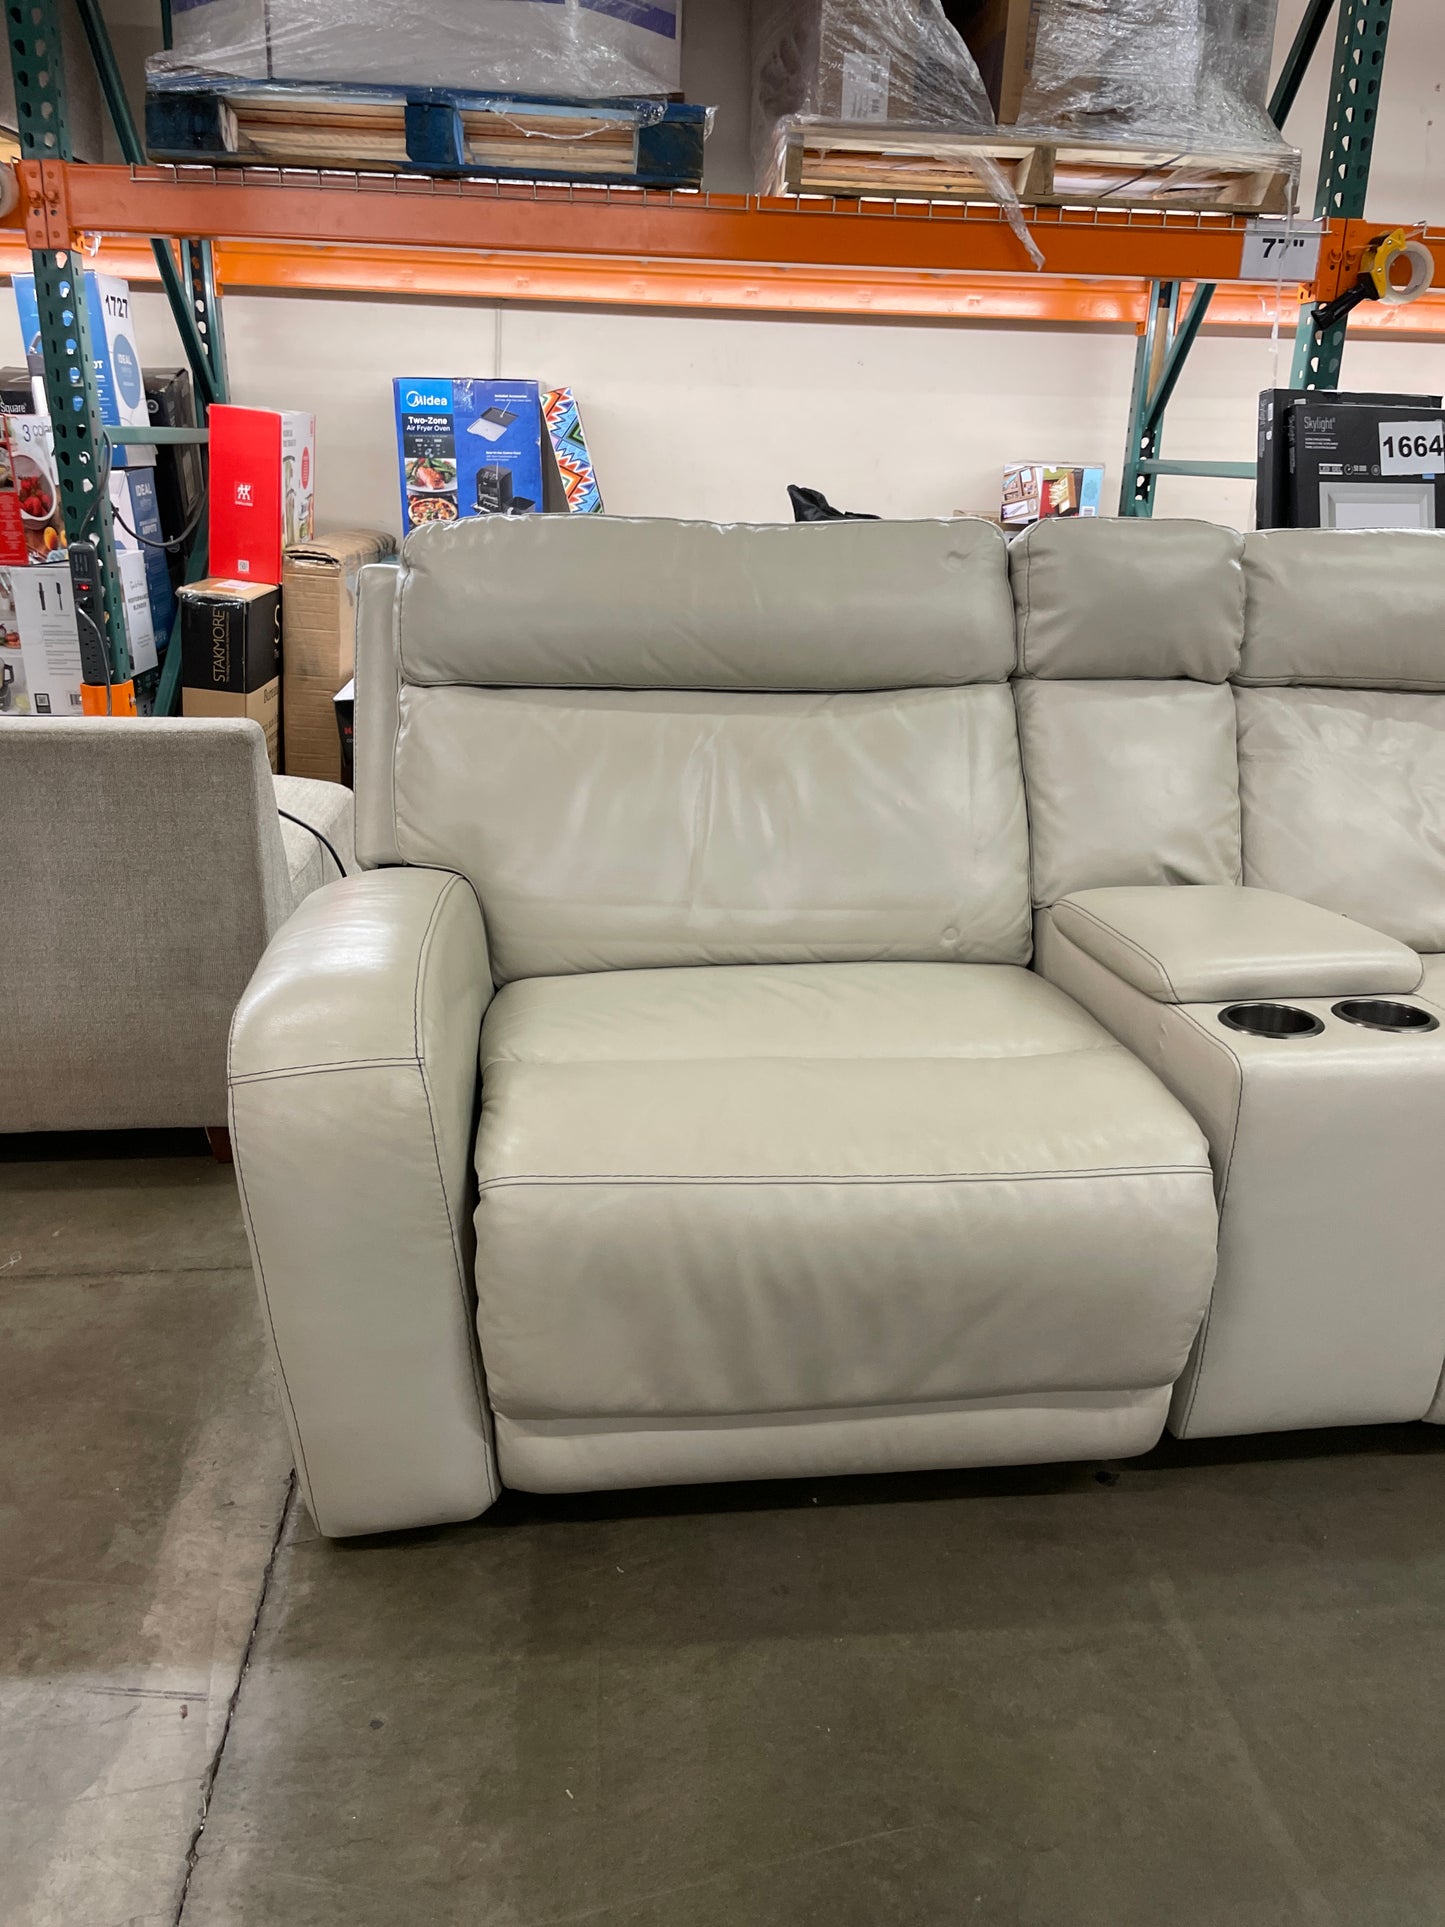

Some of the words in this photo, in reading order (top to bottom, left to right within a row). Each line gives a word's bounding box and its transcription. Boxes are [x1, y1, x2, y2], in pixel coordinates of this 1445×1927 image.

[105, 294, 128, 318] 1727
[406, 390, 448, 407] Midea
[408, 416, 448, 425] Two-Zone
[22, 424, 31, 442] 3
[1383, 435, 1444, 458] 1664
[212, 606, 226, 683] STAKMORE
